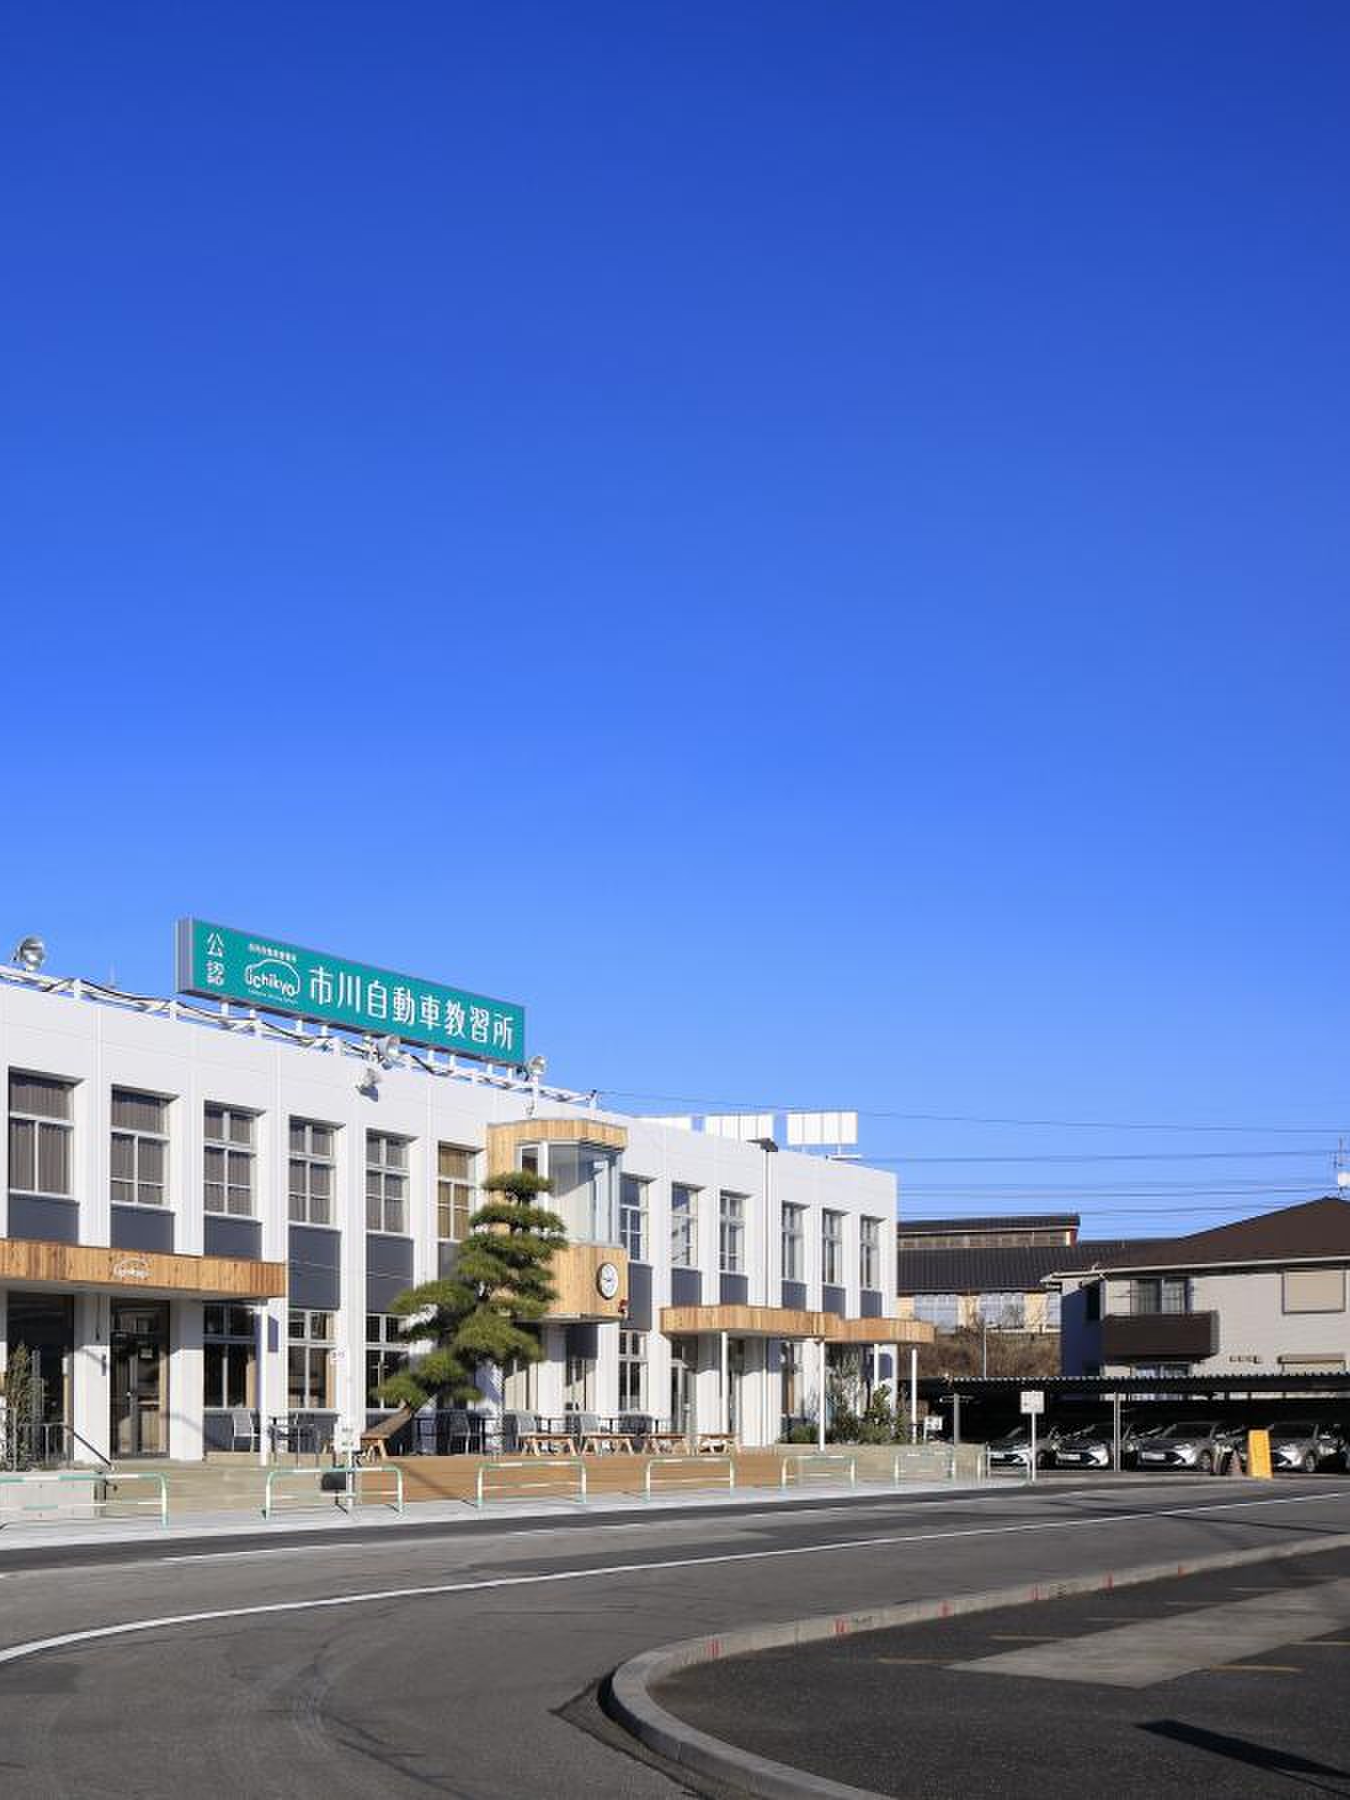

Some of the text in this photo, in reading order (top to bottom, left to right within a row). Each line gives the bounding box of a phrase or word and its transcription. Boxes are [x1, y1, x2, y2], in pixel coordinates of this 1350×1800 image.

[207, 933, 224, 986] 公認
[308, 966, 514, 1050] 市川自動車教習所
